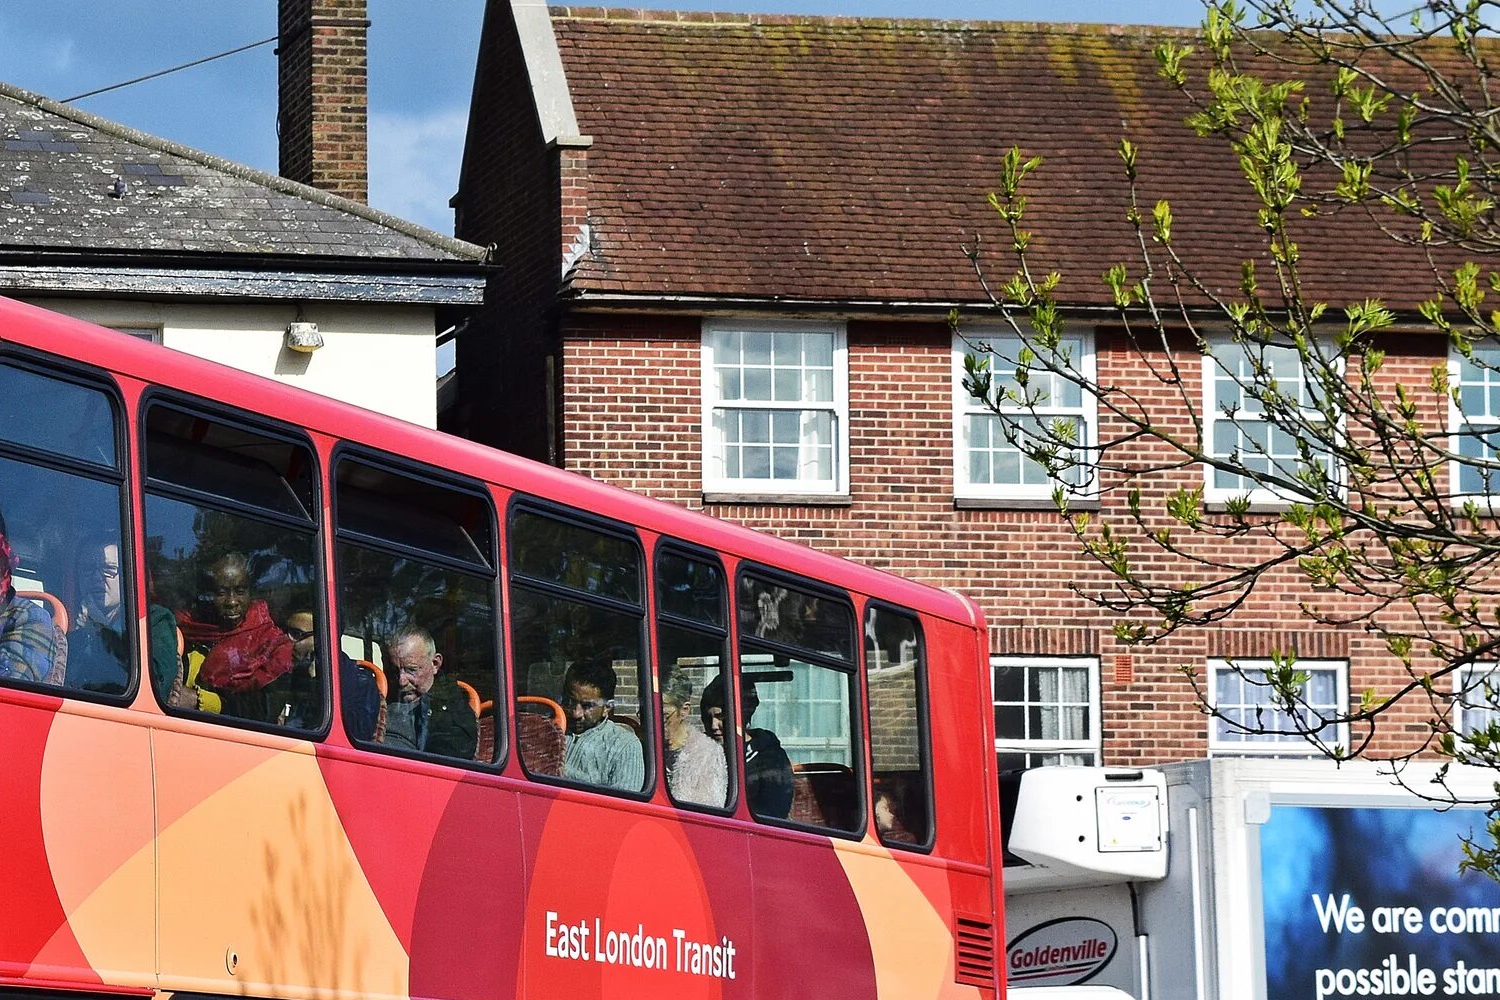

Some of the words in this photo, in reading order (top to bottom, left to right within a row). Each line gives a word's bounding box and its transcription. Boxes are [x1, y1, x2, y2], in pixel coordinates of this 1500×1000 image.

[1311, 893, 1366, 934] We
[1371, 906, 1424, 934] are
[545, 911, 590, 961] East
[595, 917, 668, 970] London
[672, 928, 736, 980] Transit
[1010, 938, 1107, 969] Goldenville
